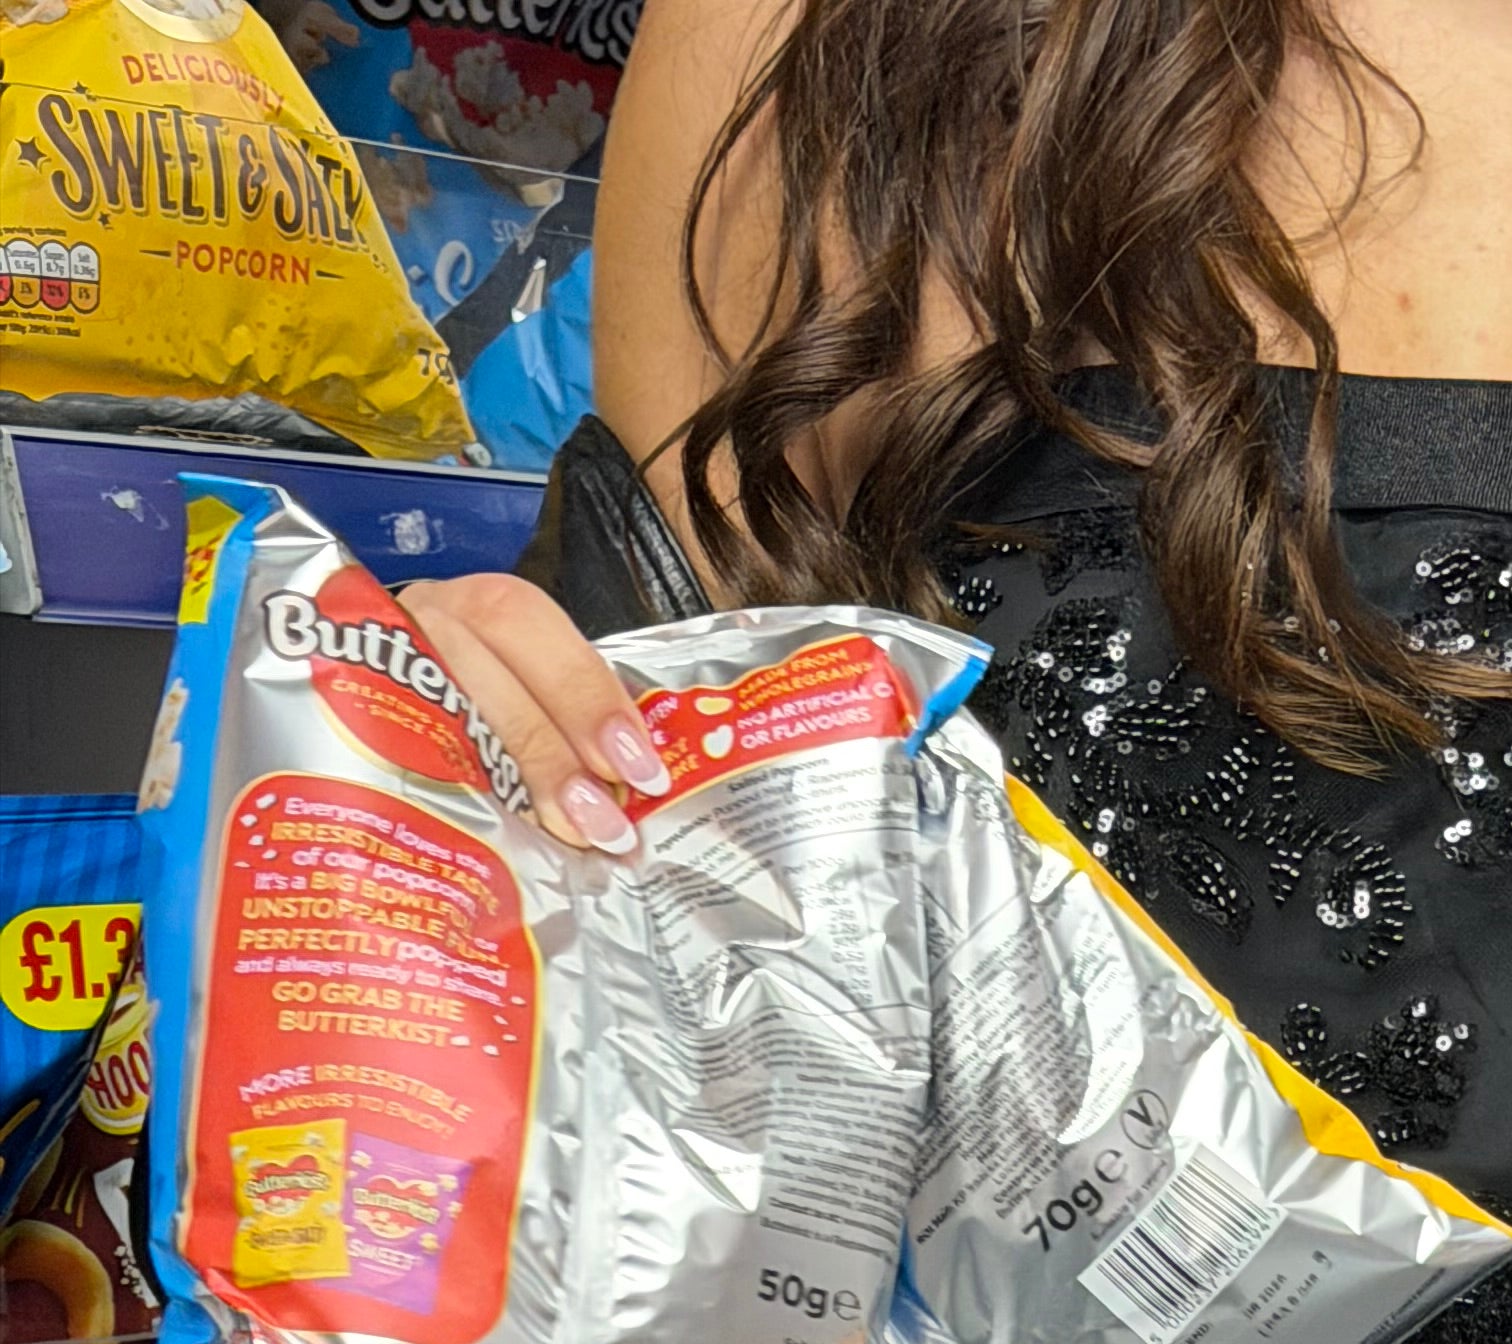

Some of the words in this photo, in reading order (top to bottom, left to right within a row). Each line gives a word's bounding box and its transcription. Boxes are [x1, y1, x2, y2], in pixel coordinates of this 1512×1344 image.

[121, 53, 285, 117] DELICIOUSLY
[38, 93, 229, 226] SWEET
[237, 133, 269, 220] &
[175, 240, 311, 285] POPCORN
[737, 711, 767, 731] NO
[767, 684, 873, 721] ARTIFICIAL
[739, 729, 772, 750] OR
[772, 706, 872, 741] FLAVOURS
[284, 797, 393, 833] Everyone
[271, 821, 439, 873] IRRESISTIBLE
[310, 871, 357, 893] BIG
[242, 898, 446, 940] UNSTOPPABLE
[19, 917, 136, 1002] £1.3
[234, 956, 275, 974] and
[238, 928, 398, 957] PERFECTLY
[396, 940, 508, 987] popped
[272, 981, 317, 1003] GO
[319, 982, 404, 1011] GRAB
[405, 991, 467, 1022] THE
[277, 1010, 452, 1048] BUTTERKIST
[239, 1065, 313, 1103] MORE
[314, 1064, 474, 1123] IRRESISTIBLE
[1022, 1178, 1104, 1253] 70g
[757, 1267, 829, 1319] 50g
